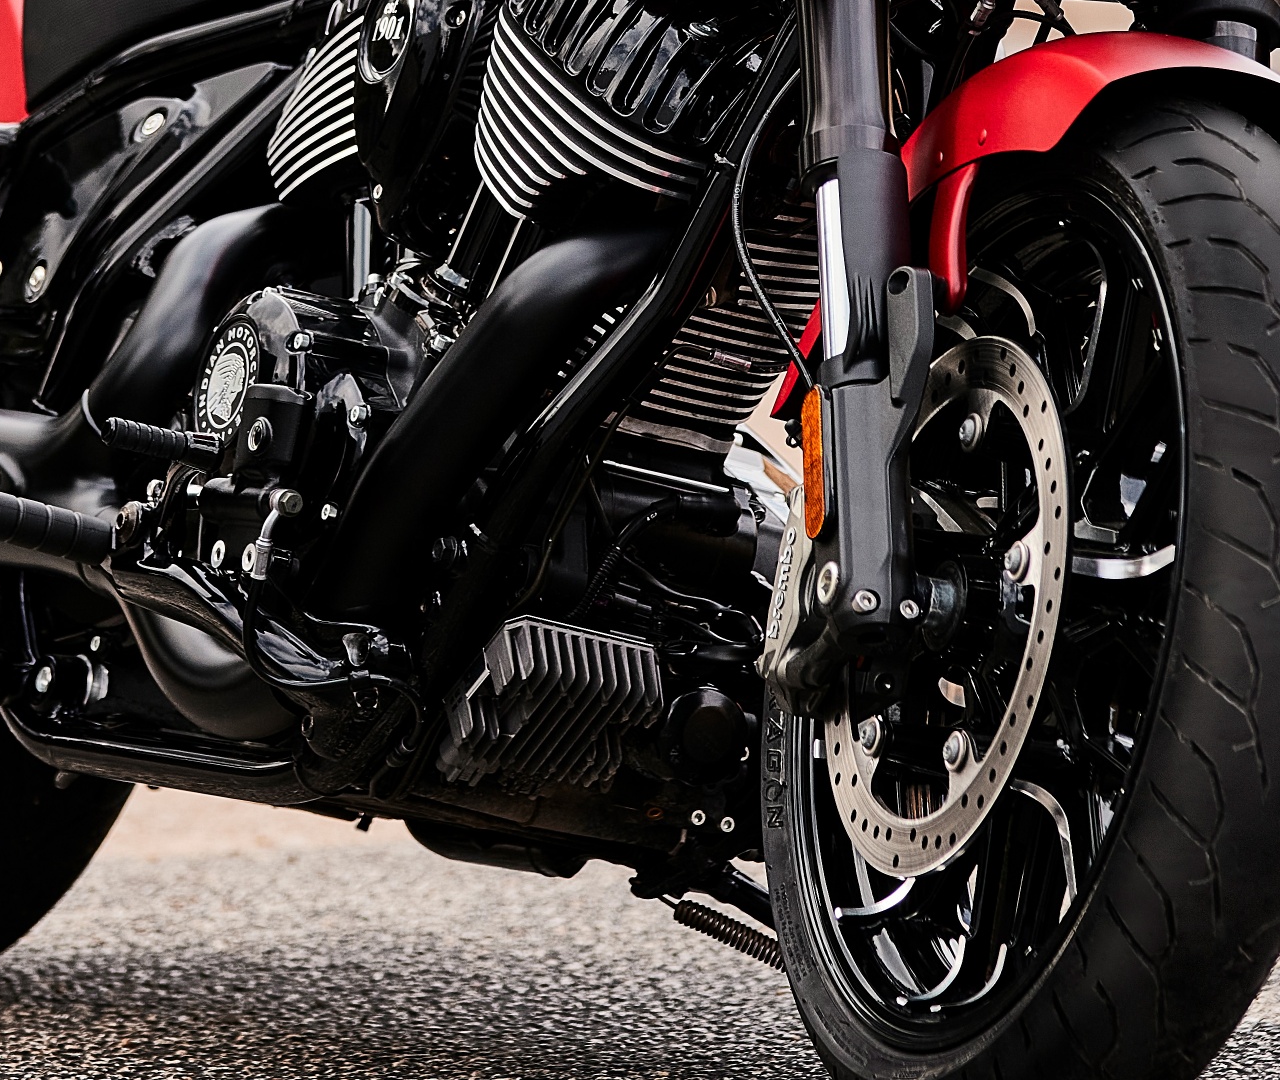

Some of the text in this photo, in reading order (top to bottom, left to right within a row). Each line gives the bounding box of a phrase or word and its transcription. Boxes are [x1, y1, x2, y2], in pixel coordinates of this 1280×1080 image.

[372, 16, 405, 41] 1901
[199, 326, 258, 427] INDIAN MOTORCYE
[767, 527, 796, 639] brembo
